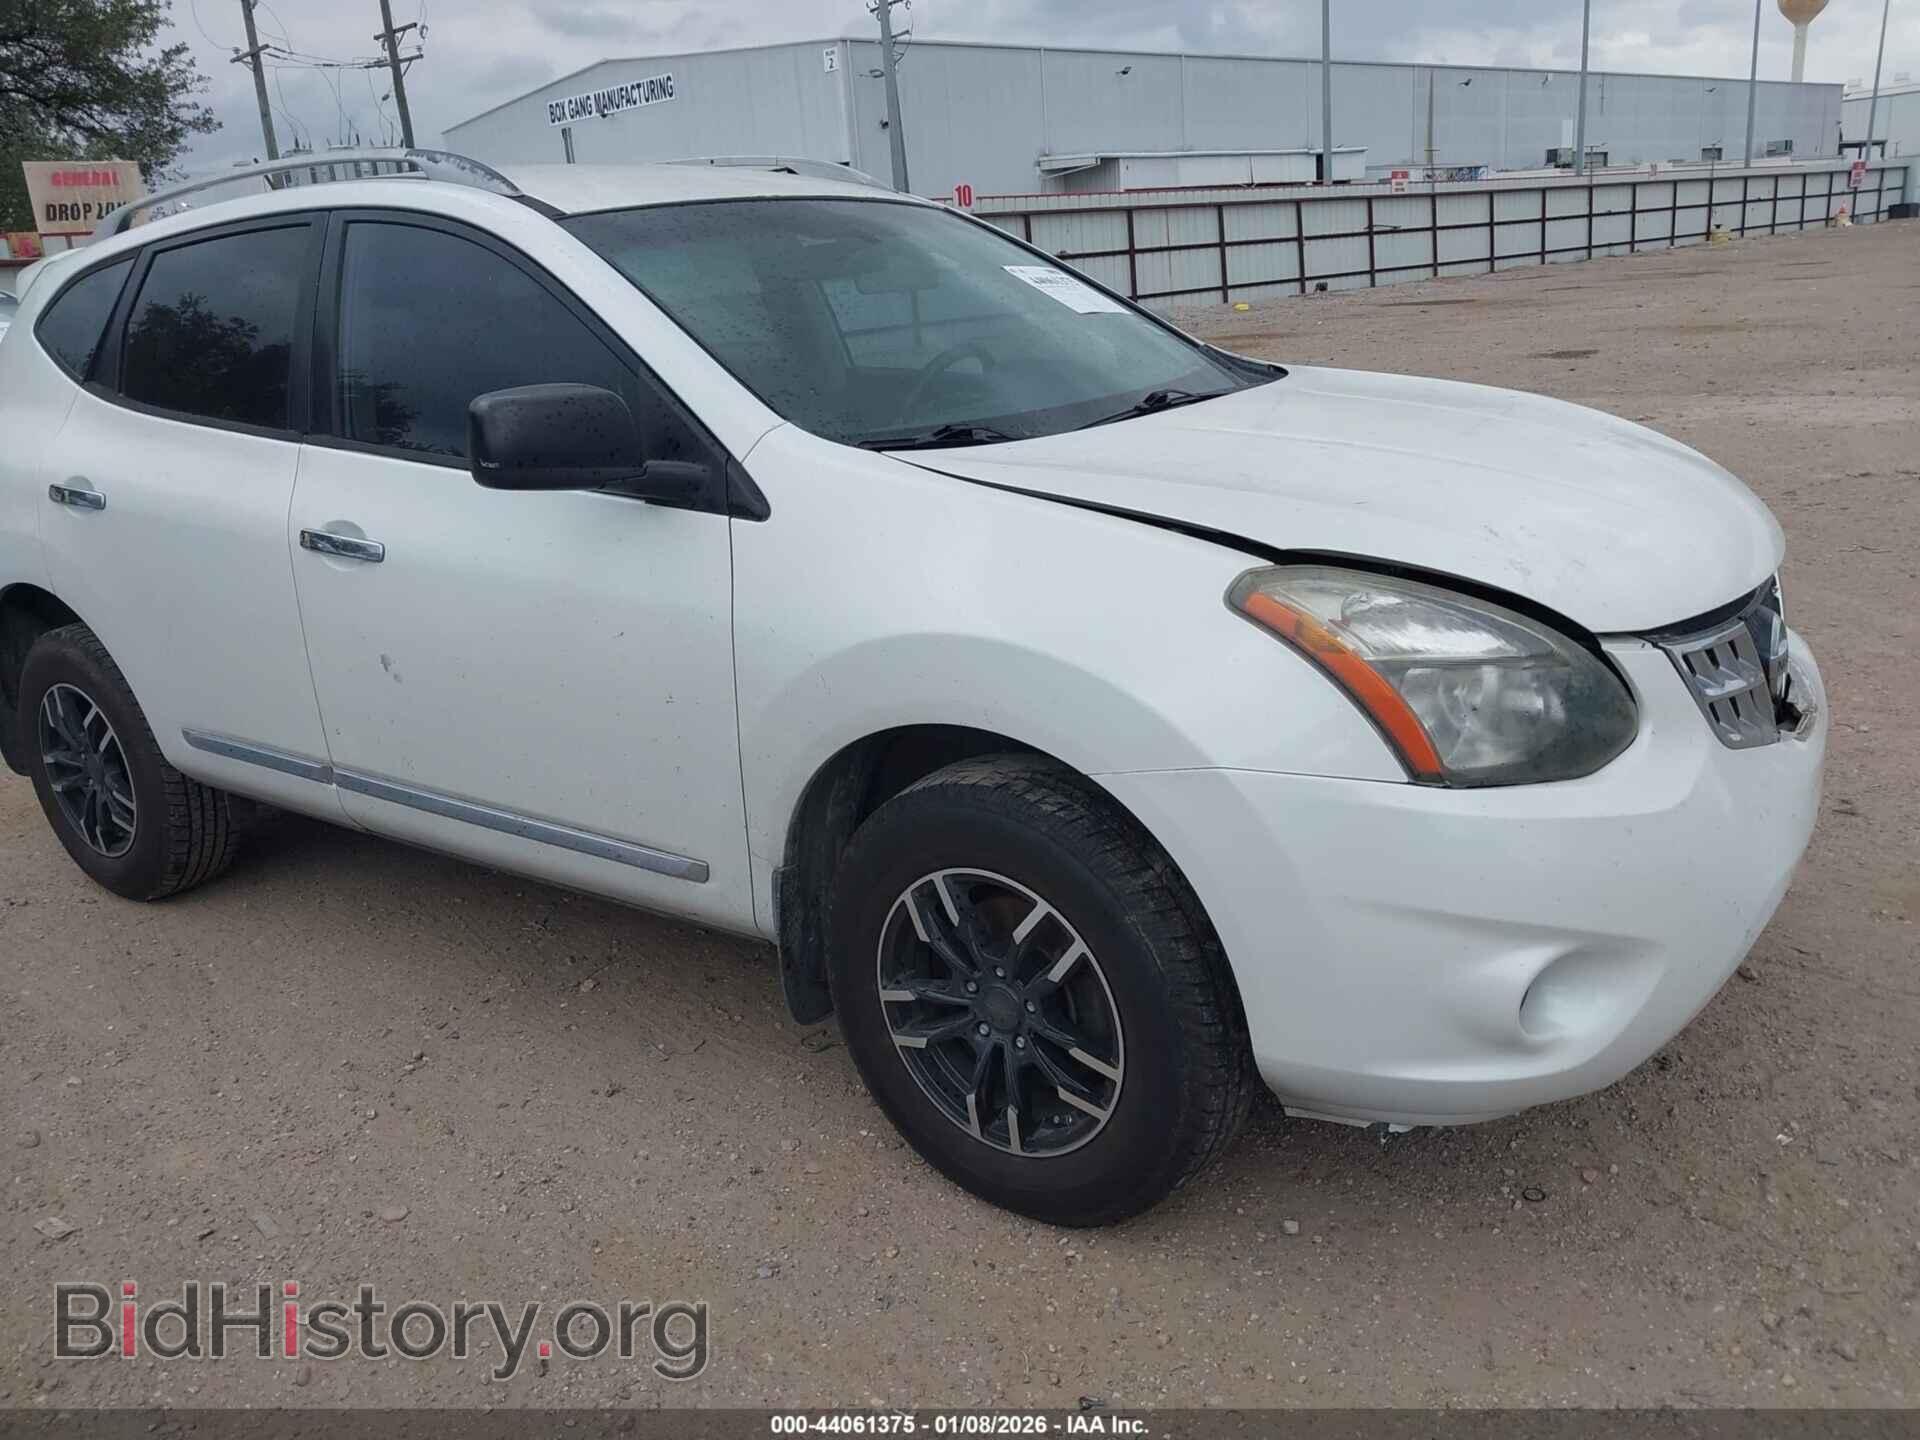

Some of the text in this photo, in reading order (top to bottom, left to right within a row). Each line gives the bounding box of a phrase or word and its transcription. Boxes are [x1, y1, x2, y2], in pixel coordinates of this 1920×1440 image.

[548, 75, 674, 124] BOX GANG MANUFACTURING
[954, 184, 972, 207] 10
[45, 202, 92, 221] DROP
